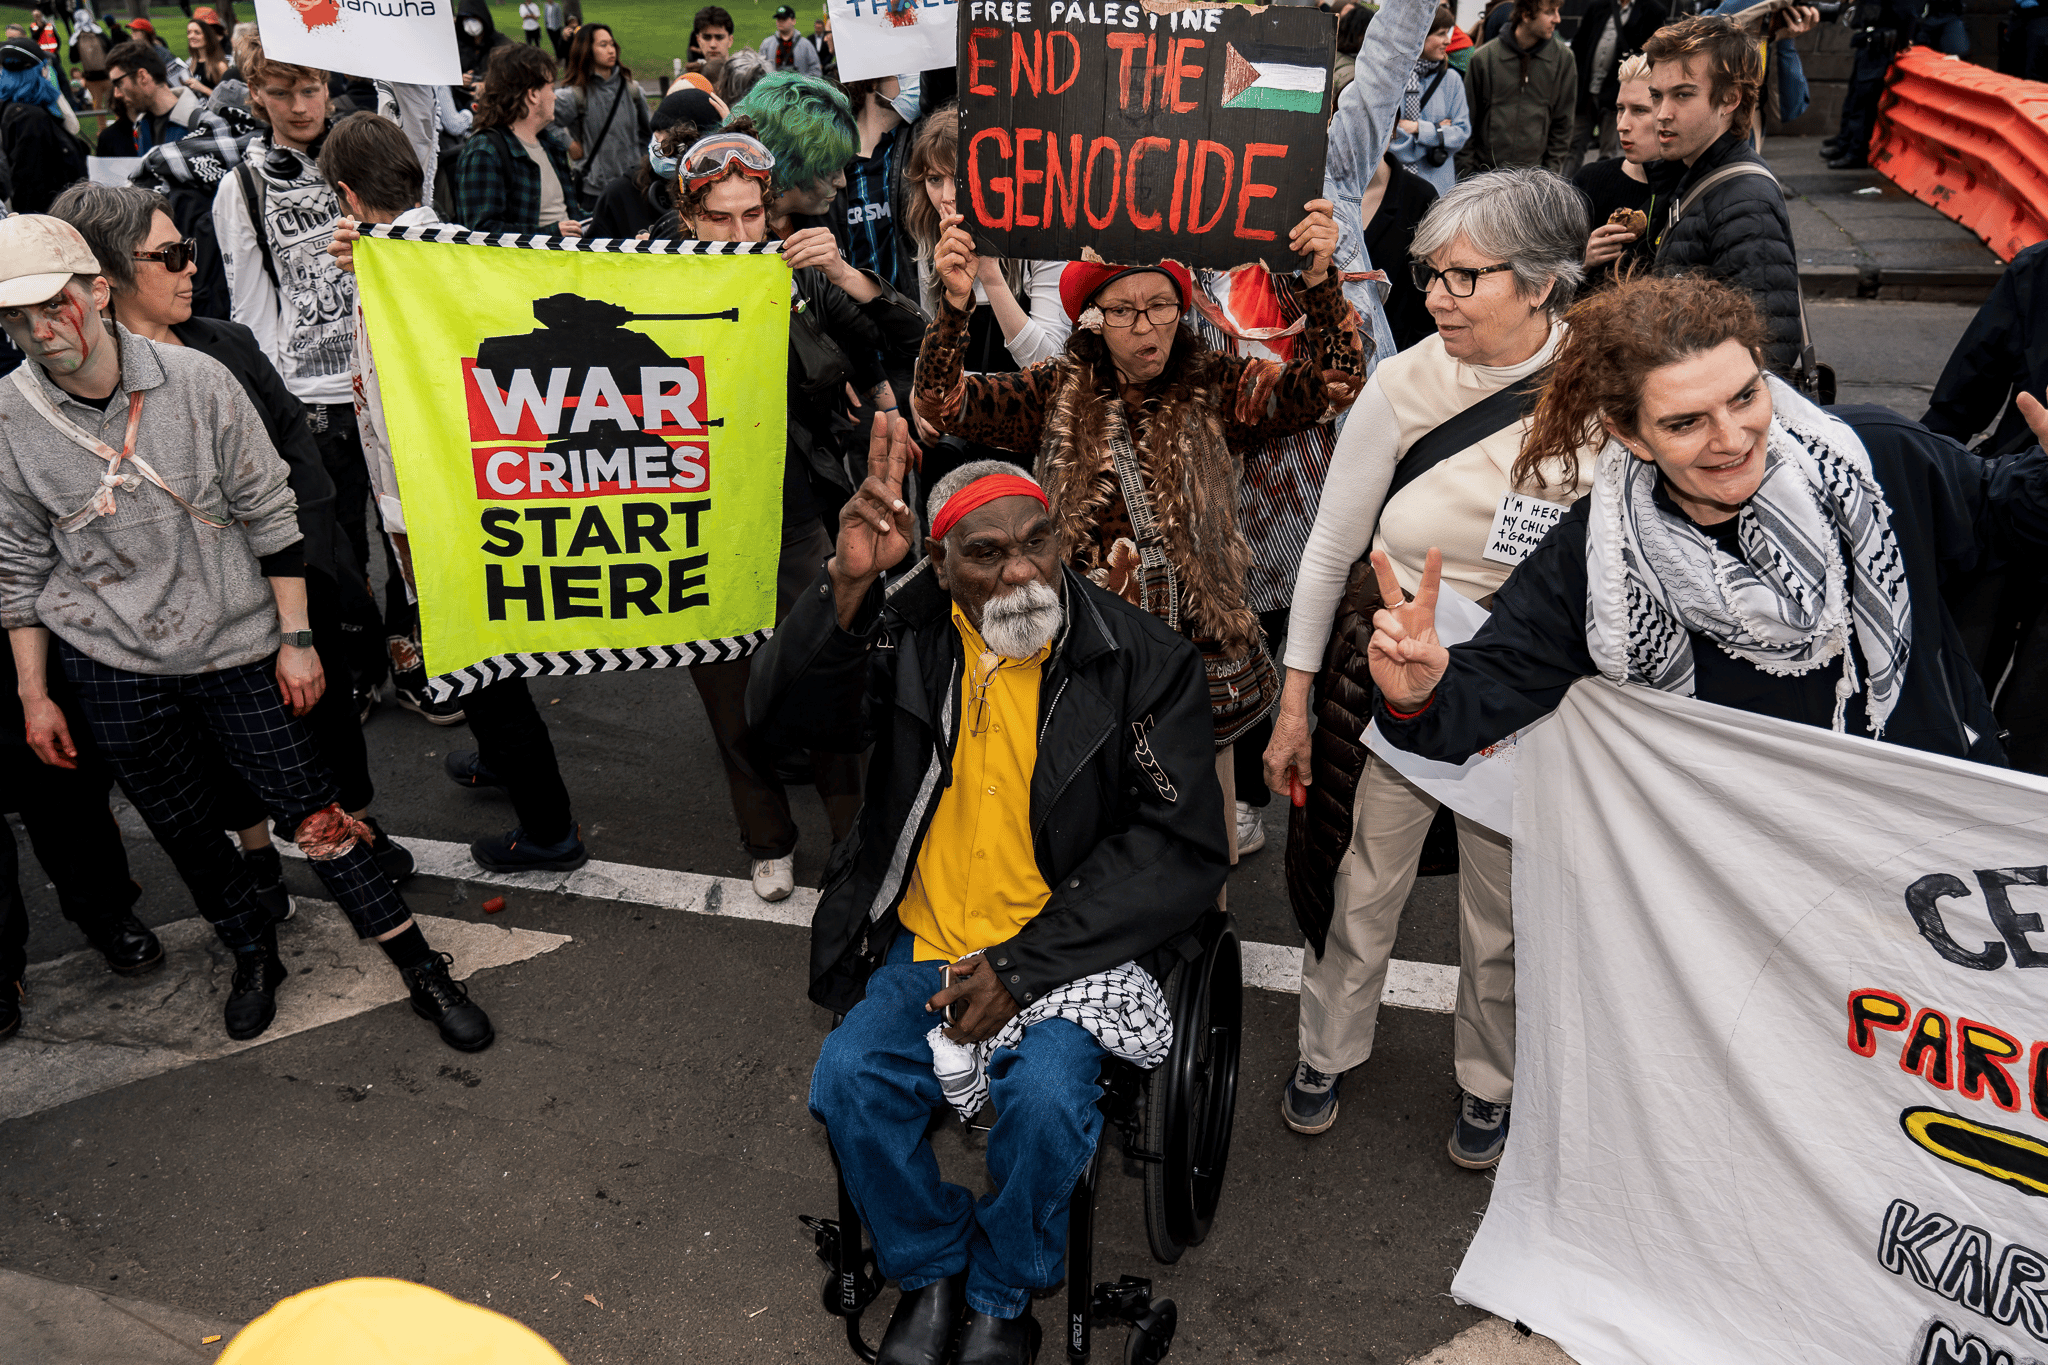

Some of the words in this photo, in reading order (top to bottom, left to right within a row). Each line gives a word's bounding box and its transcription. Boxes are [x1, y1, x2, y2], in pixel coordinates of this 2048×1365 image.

[328, 0, 436, 17] anwha
[971, 1, 1032, 23] FREE
[968, 27, 1081, 98] END
[1106, 32, 1205, 114] THE
[967, 127, 1289, 242] GENOCIDE
[471, 366, 702, 435] WAR
[485, 445, 707, 496] CRIMES
[480, 498, 712, 558] START
[1502, 515, 1519, 532] MY
[1503, 497, 1523, 513] I'M
[1492, 541, 1517, 556] AND
[485, 552, 710, 622] HERE
